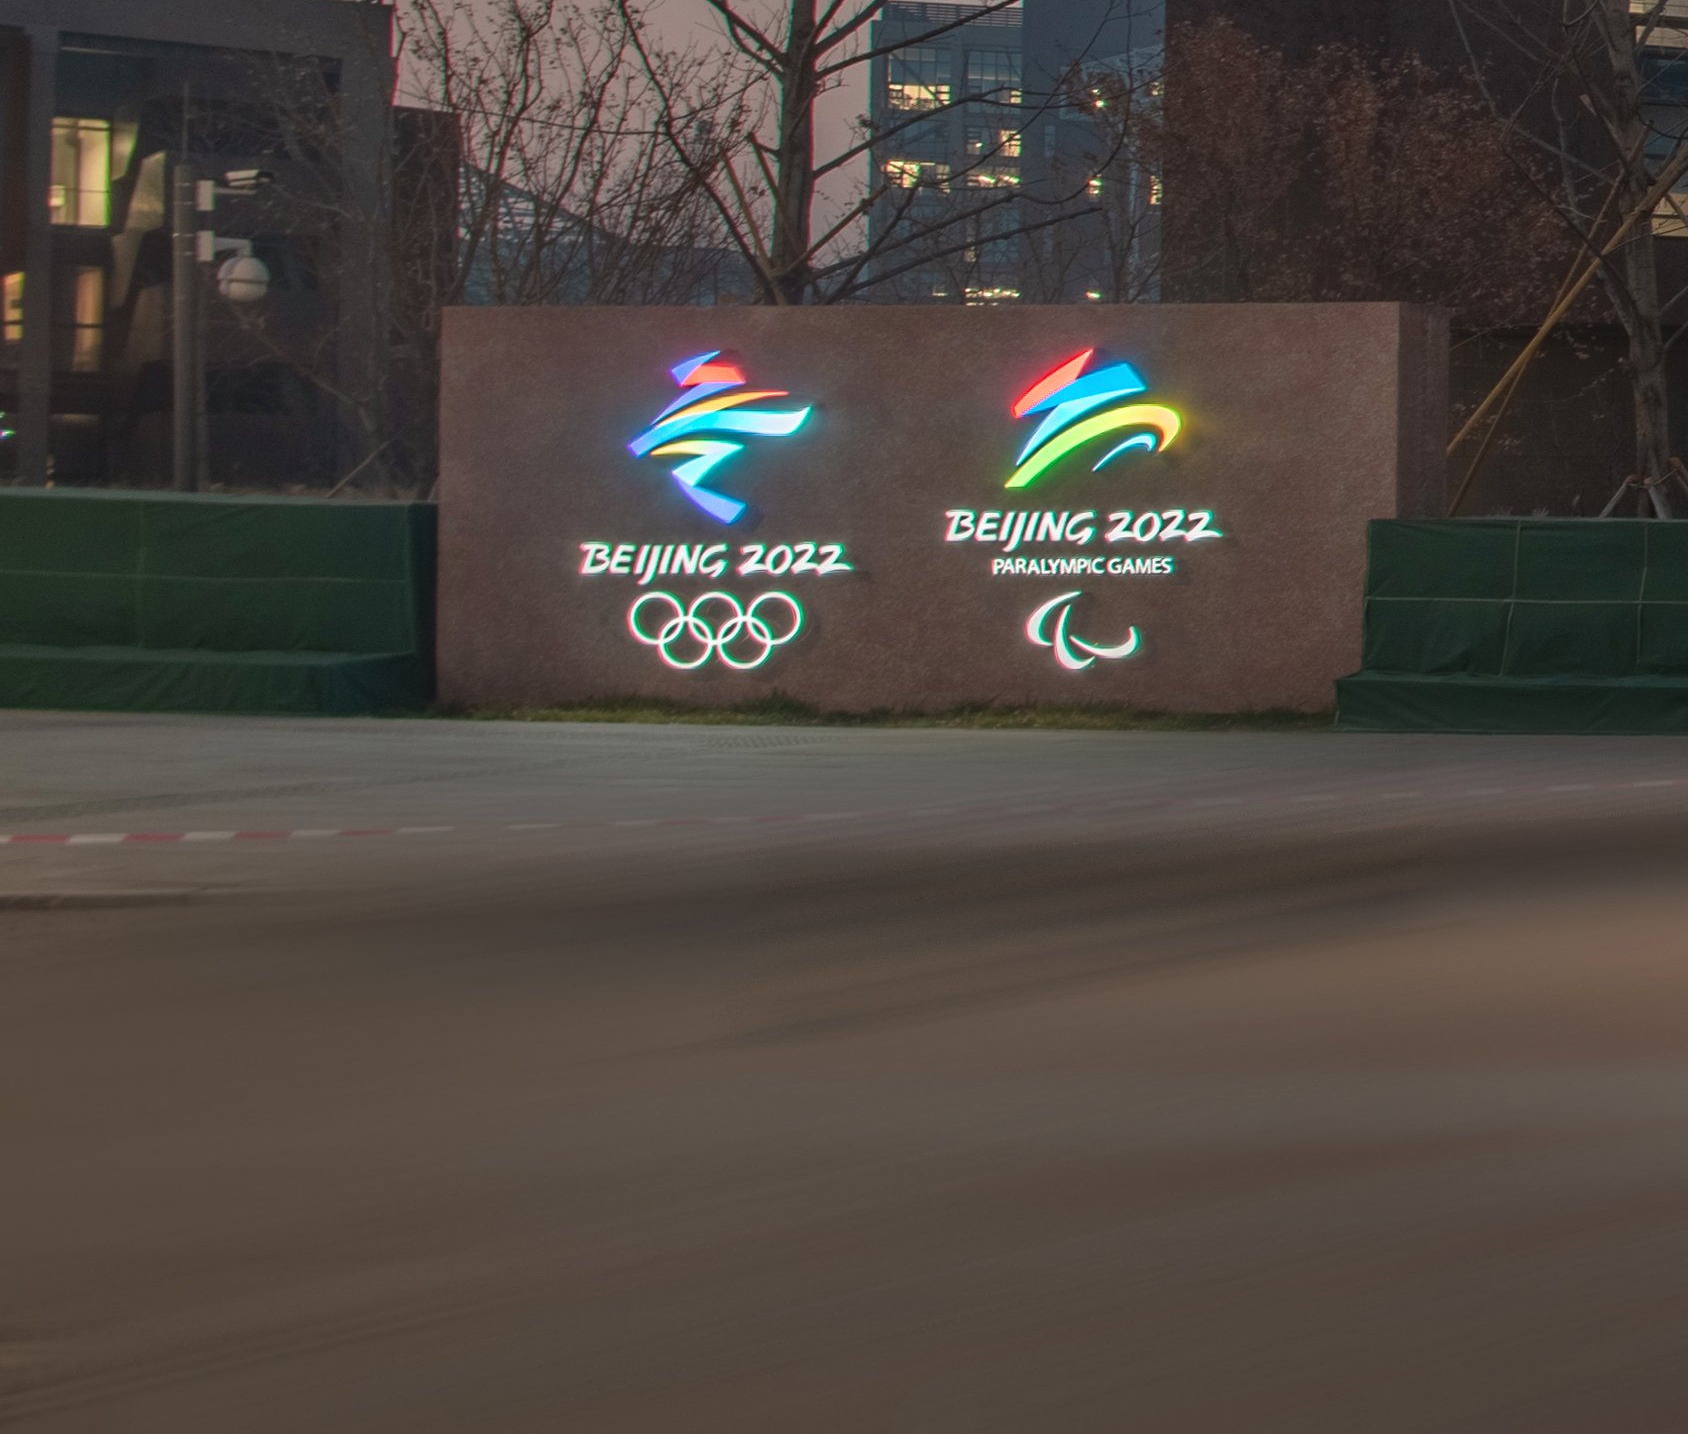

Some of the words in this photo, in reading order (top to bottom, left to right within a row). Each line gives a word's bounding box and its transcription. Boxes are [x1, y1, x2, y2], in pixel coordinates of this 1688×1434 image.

[945, 509, 1095, 552] BEIJING
[1105, 509, 1223, 542] 2022
[579, 542, 728, 585] BEIJING
[736, 541, 854, 575] 2022
[992, 557, 1105, 575] PARALYMPIC
[1106, 556, 1173, 574] GAMES
